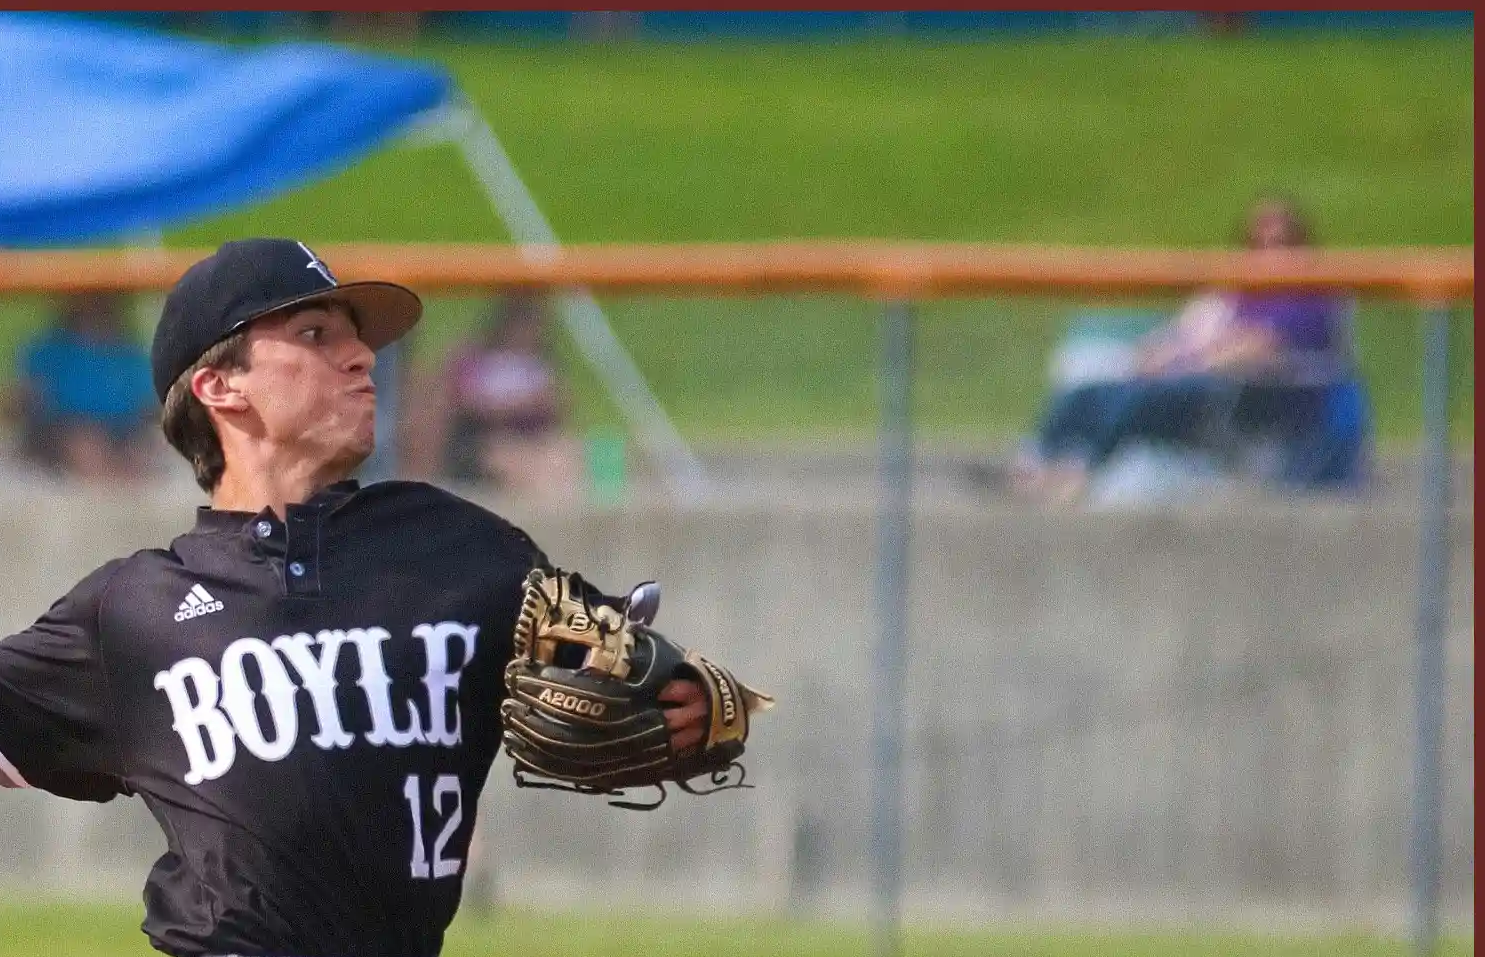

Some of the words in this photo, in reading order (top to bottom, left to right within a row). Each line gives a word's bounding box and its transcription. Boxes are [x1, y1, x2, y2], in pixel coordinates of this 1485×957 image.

[173, 600, 225, 622] adidas
[153, 620, 480, 785] BOYLE
[538, 687, 607, 717] A2000
[403, 773, 463, 880] 12
